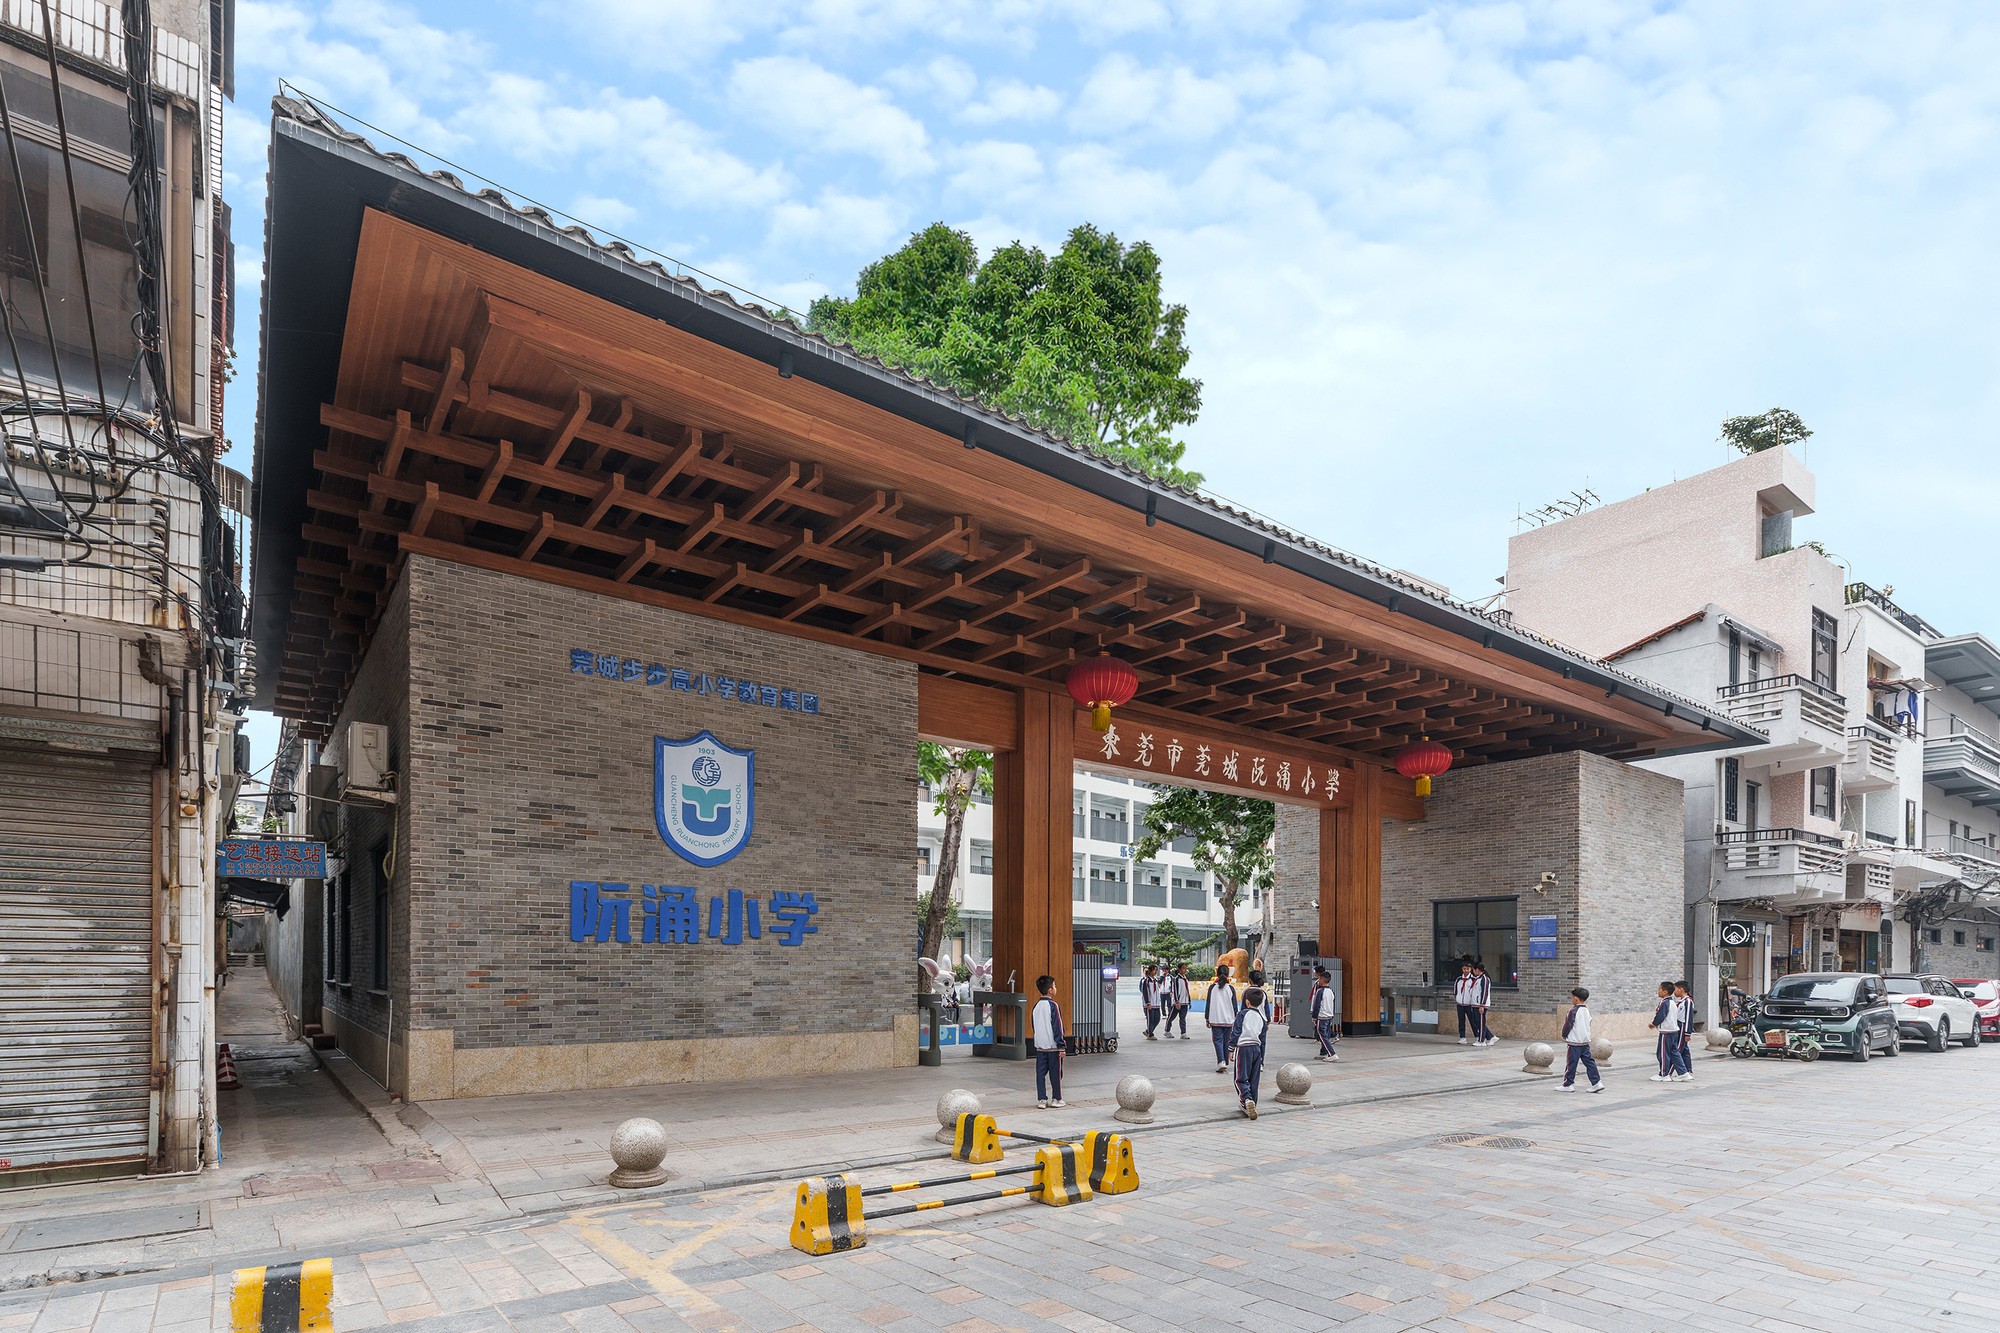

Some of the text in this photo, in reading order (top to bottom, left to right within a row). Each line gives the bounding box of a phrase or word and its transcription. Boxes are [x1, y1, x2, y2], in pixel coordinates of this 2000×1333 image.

[570, 649, 818, 714] 莞城步步高小学教育集团
[698, 747, 716, 756] 1903
[670, 774, 679, 826] GUANCHENG
[676, 827, 720, 849] RUANCHONG
[722, 818, 741, 847] PRIMARY
[223, 842, 322, 863] 艺进接送站
[238, 862, 318, 871] 13549417171
[571, 880, 818, 946] 阮涌小学
